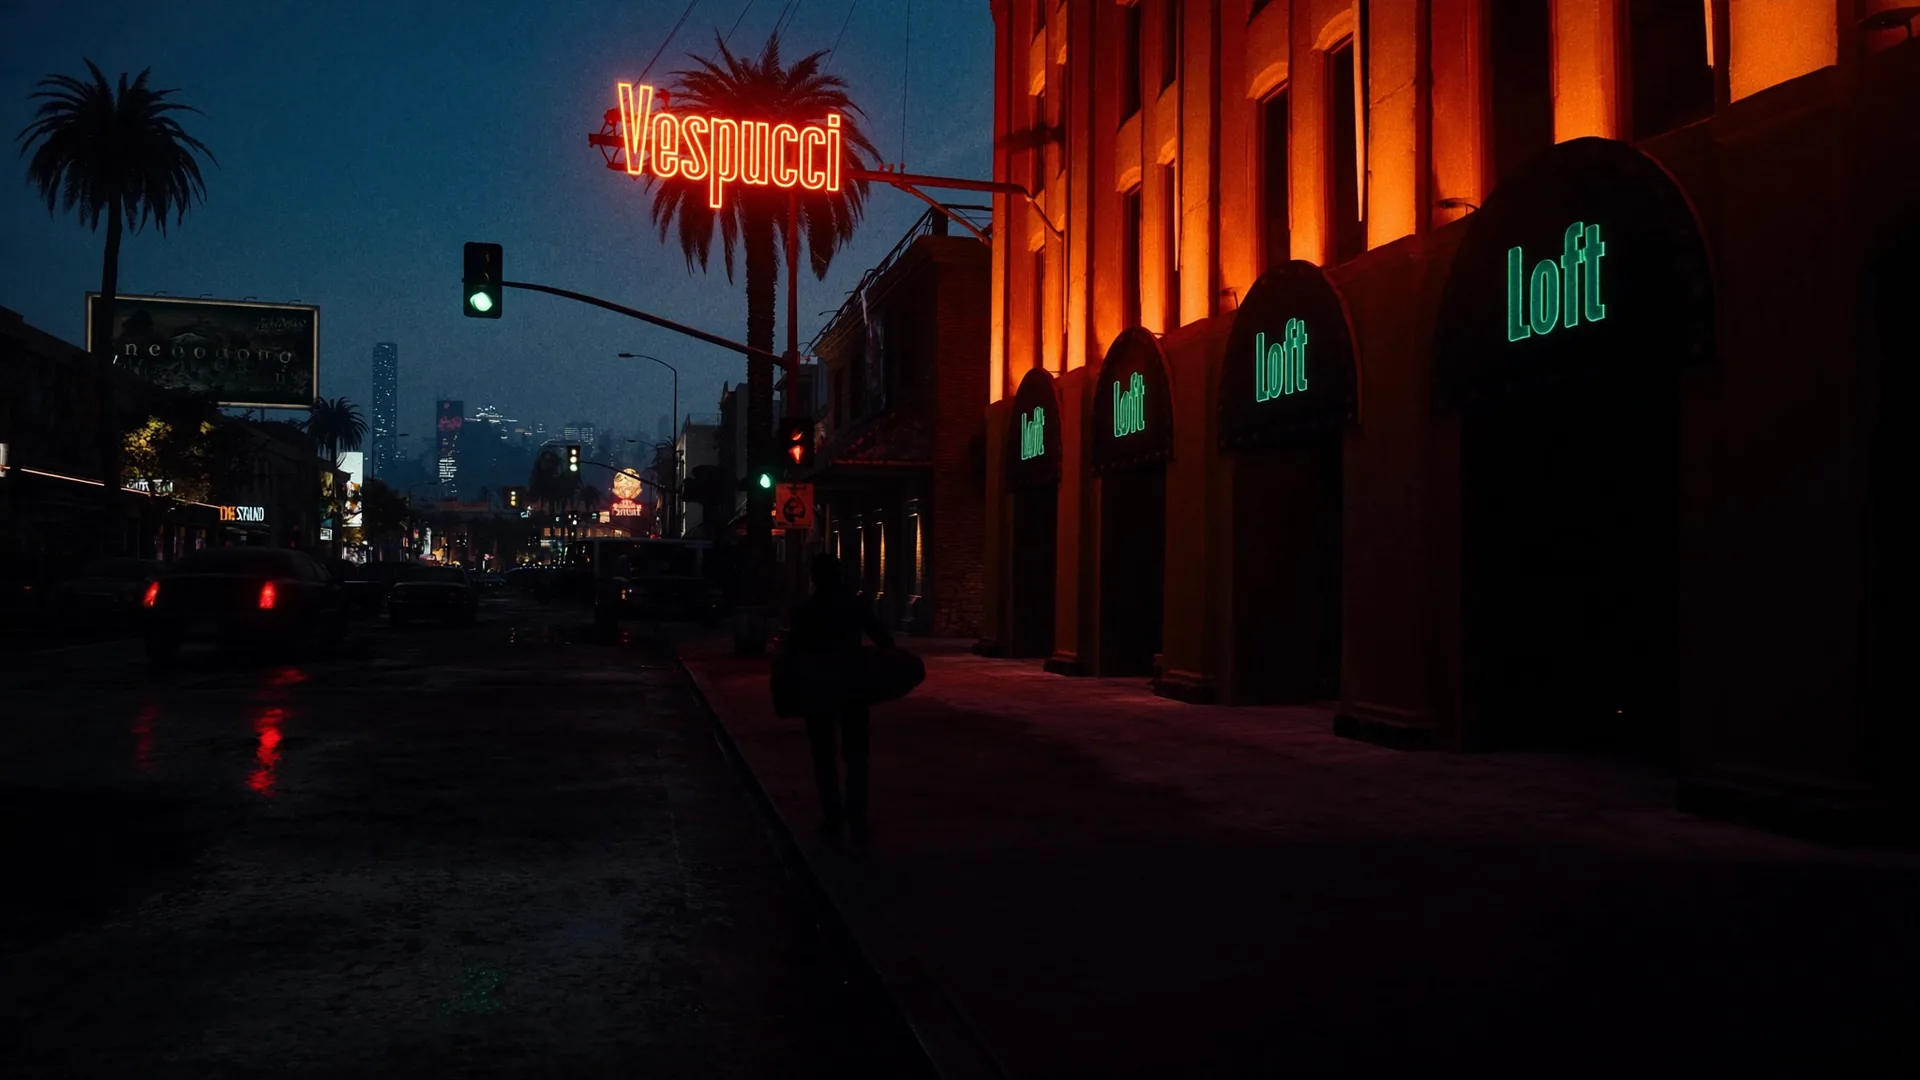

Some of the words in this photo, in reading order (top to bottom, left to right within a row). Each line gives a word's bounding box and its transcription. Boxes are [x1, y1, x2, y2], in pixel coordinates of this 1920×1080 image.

[617, 82, 841, 208] Vespucci
[1507, 221, 1605, 342] Loft
[1256, 318, 1308, 402] Loft
[1021, 406, 1045, 460] Loft
[1113, 372, 1145, 437] Loft
